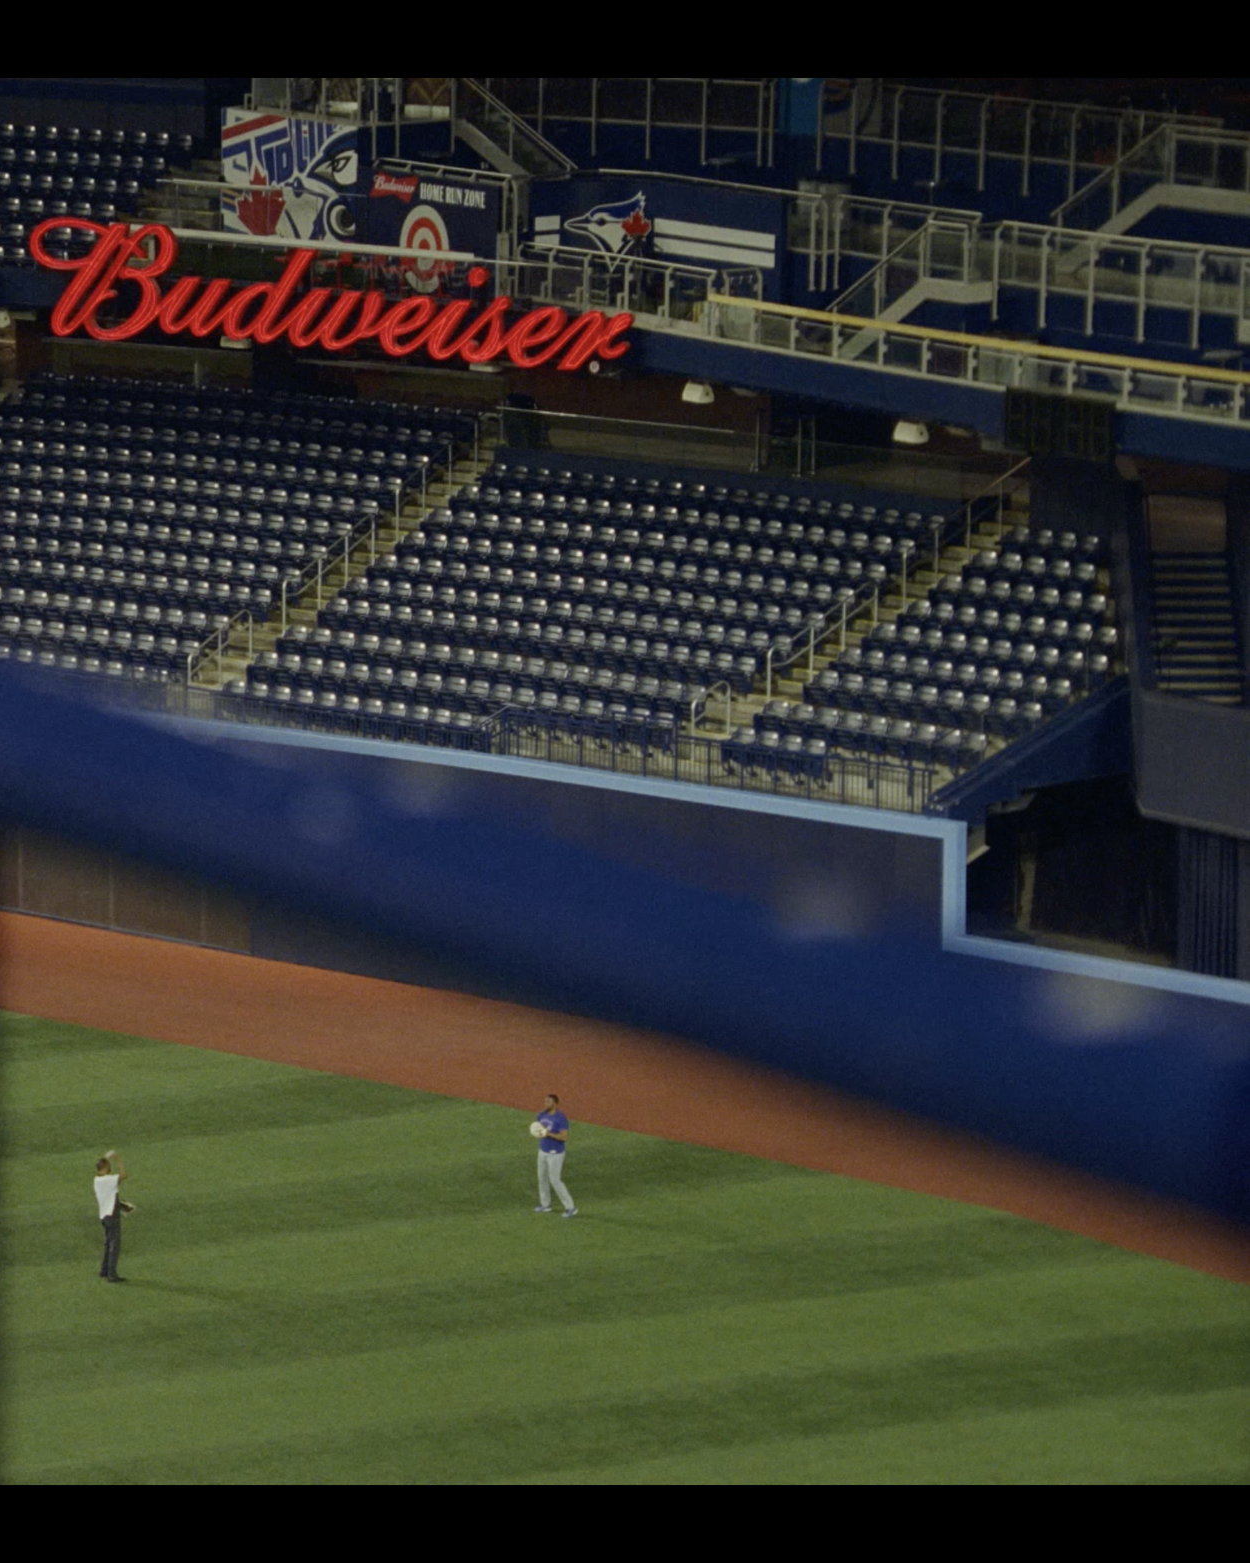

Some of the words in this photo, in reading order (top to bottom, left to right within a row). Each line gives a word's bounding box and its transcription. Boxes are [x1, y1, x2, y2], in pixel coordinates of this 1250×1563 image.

[373, 175, 416, 193] Budweiser
[420, 182, 444, 202] HOME
[445, 187, 464, 205] RUN
[464, 190, 486, 209] ZONE
[29, 216, 635, 371] Budweiser
